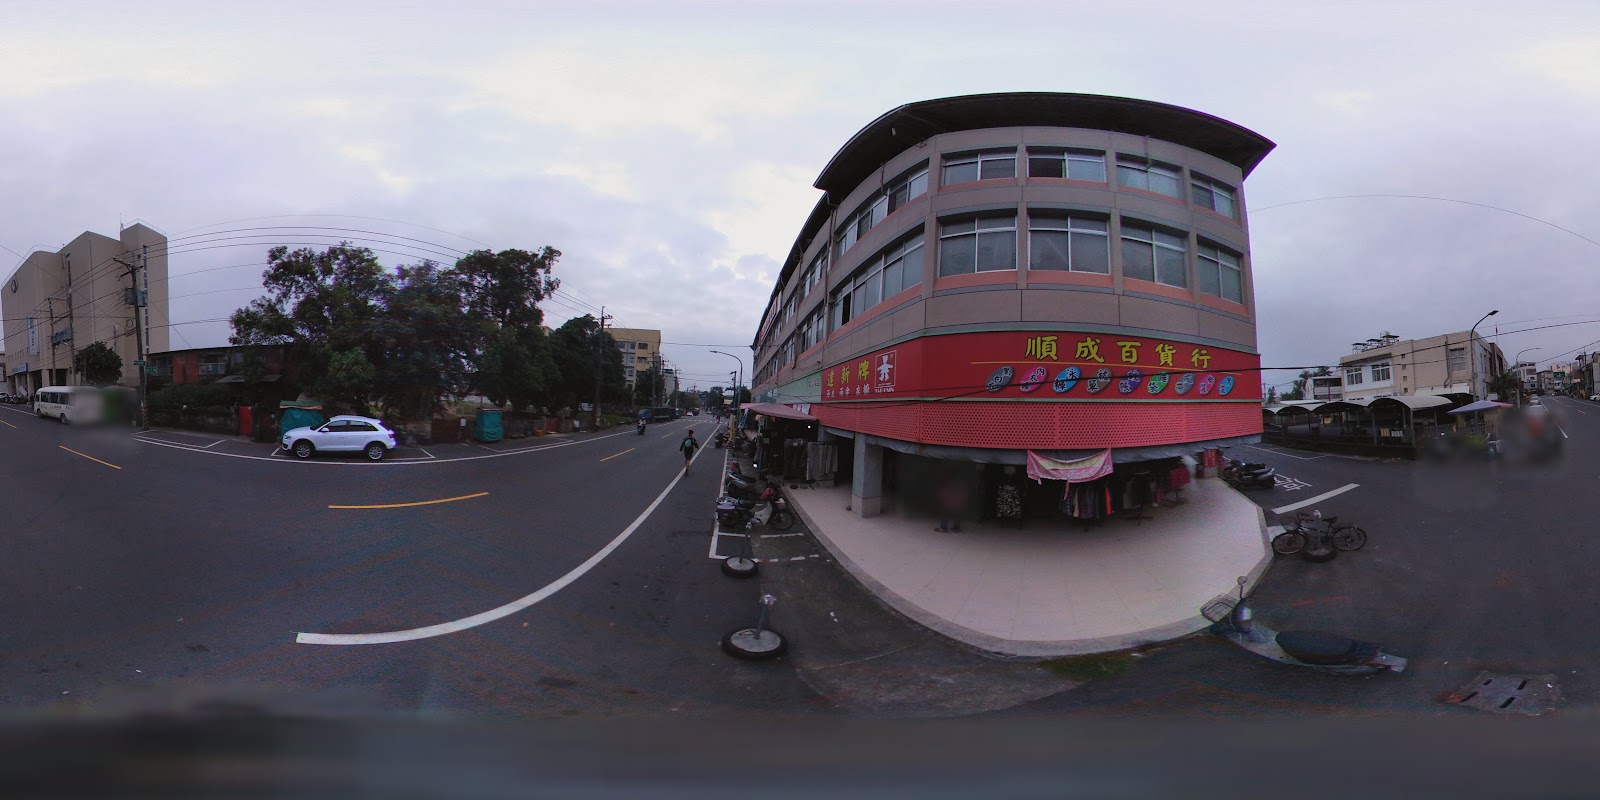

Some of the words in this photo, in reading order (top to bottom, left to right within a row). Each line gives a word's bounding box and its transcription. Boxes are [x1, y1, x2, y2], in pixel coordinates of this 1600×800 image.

[1025, 335, 1212, 370] 順成百貨行
[827, 359, 870, 388] 達新牌
